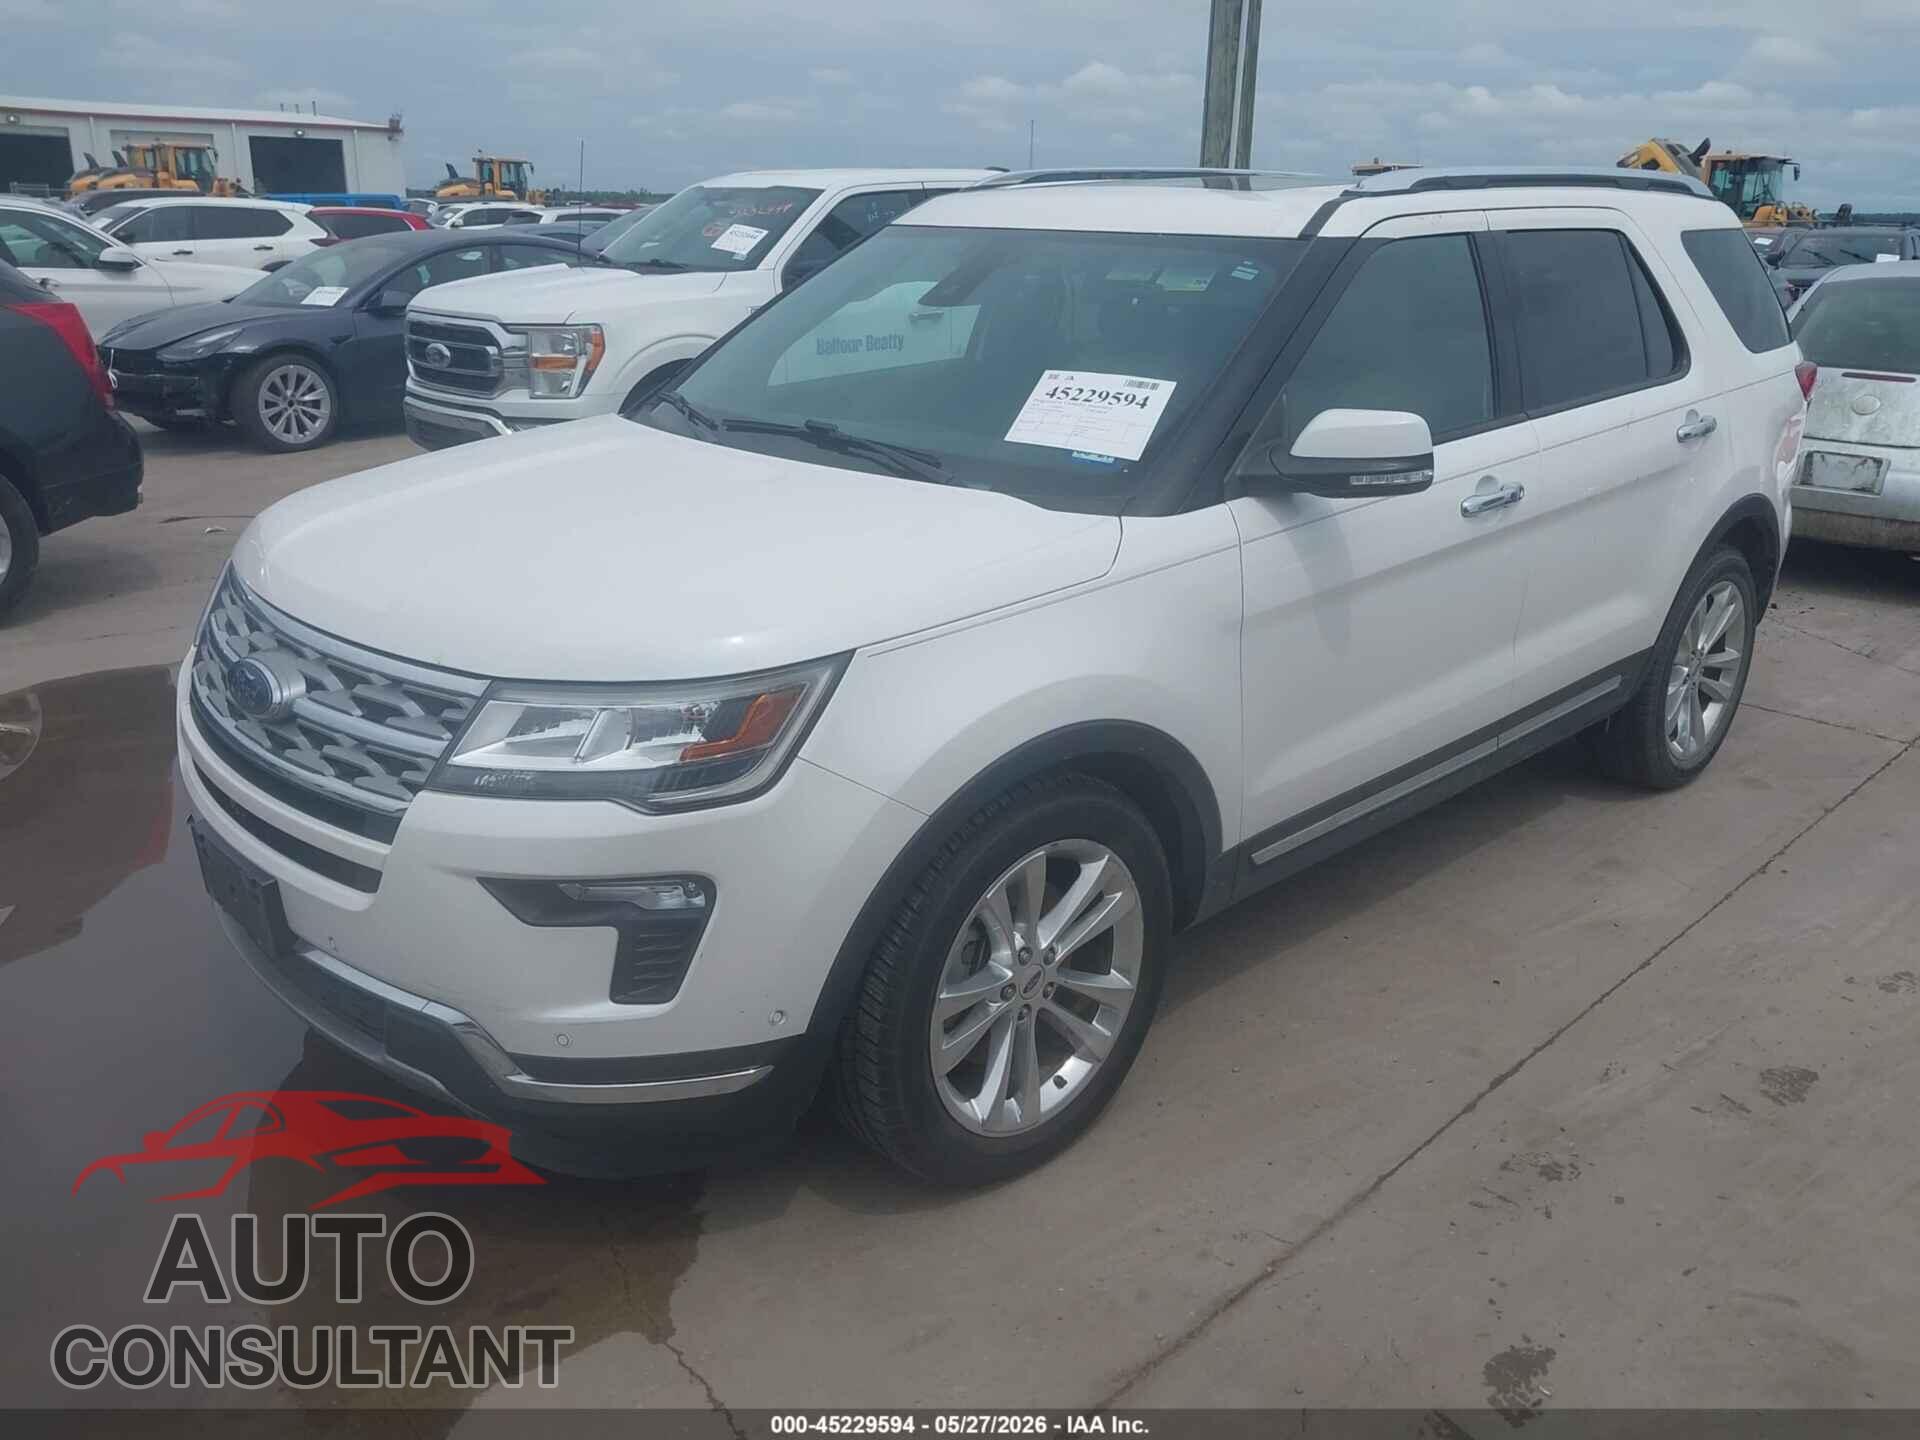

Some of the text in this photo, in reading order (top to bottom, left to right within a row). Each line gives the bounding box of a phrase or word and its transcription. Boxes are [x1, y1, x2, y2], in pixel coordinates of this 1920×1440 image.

[816, 334, 905, 356] Balfour Beatty
[1045, 385, 1151, 410] 45229594
